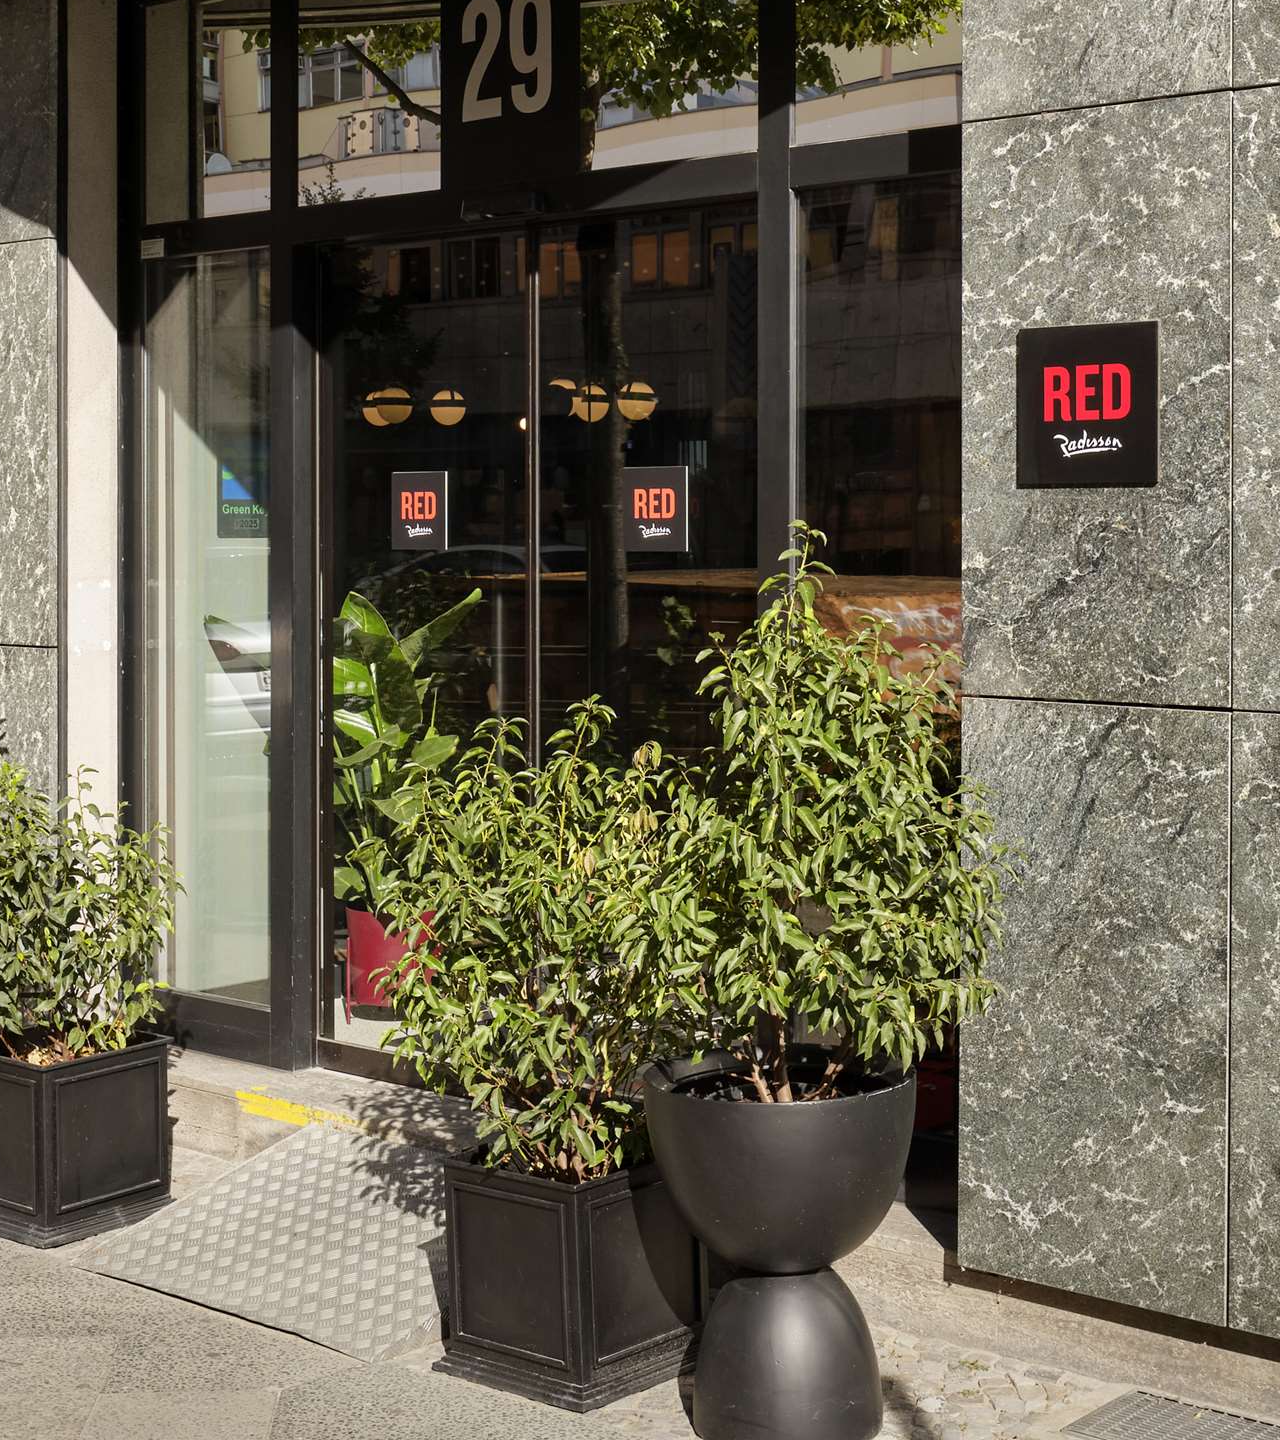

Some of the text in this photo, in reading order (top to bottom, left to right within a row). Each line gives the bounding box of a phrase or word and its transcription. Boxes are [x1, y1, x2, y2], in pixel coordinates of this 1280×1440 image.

[1043, 363, 1132, 422] RED
[1053, 429, 1123, 458] Radisson
[222, 504, 251, 515] Green
[400, 491, 437, 520] RED
[632, 488, 676, 520] RED
